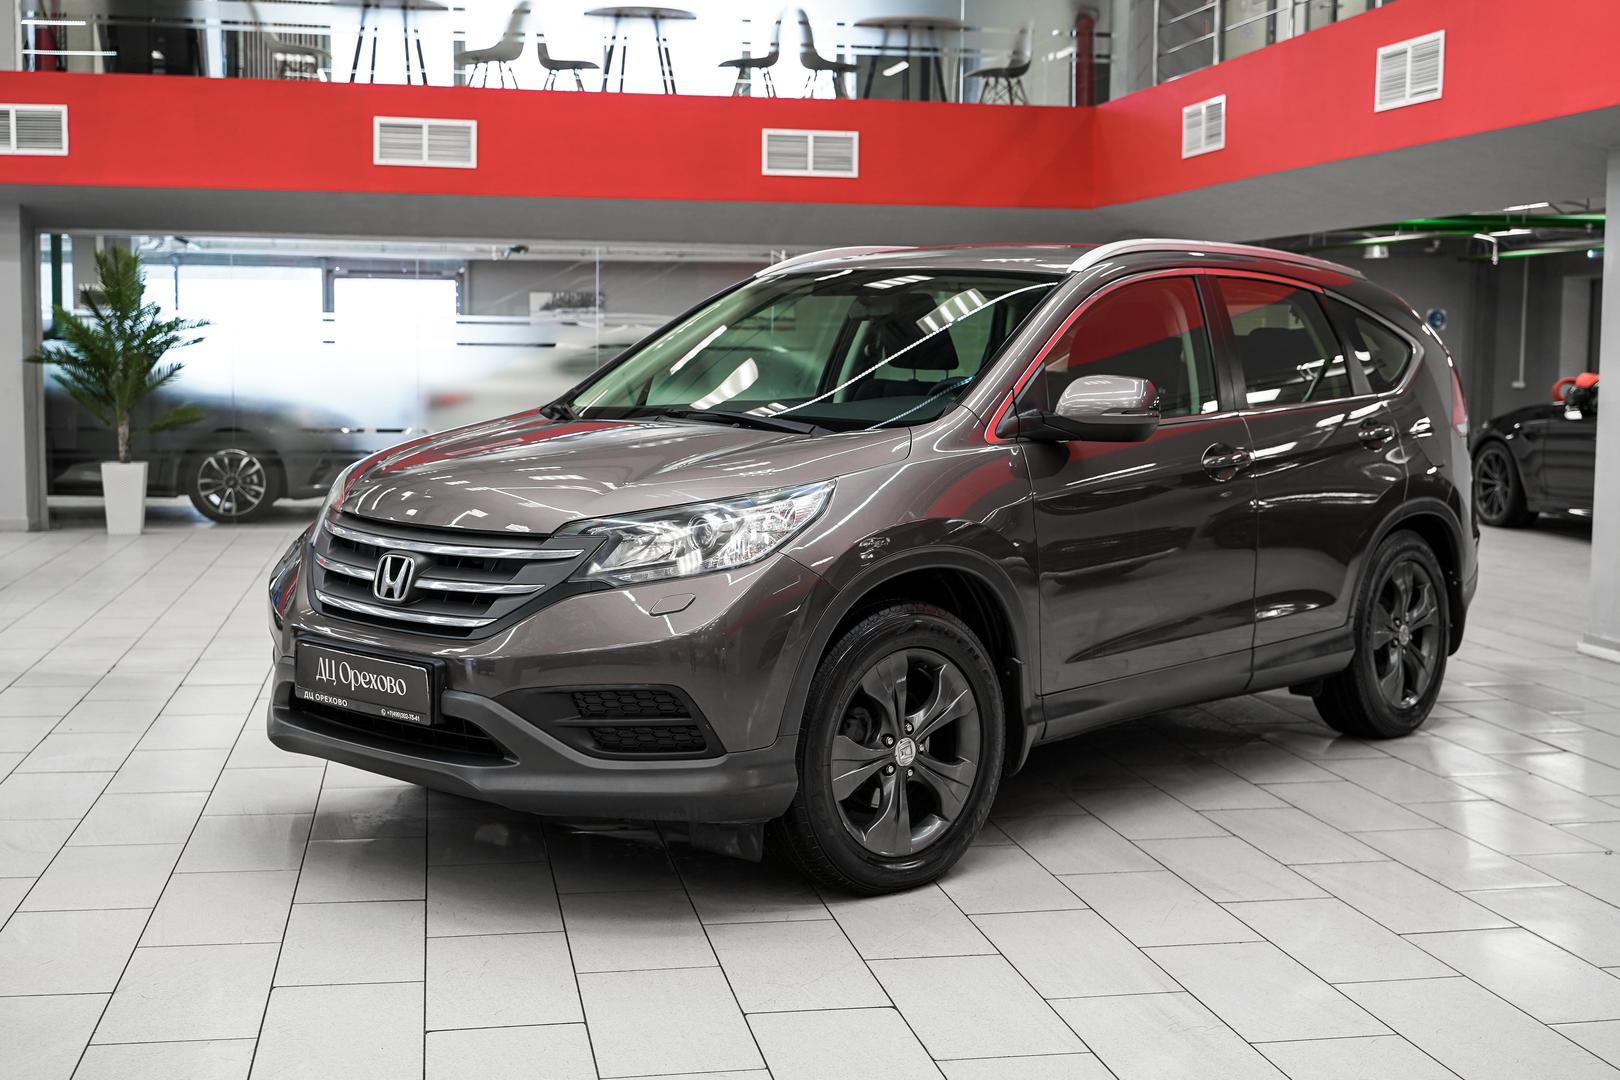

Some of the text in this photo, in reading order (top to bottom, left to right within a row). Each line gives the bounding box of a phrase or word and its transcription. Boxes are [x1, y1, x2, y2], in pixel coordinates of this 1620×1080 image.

[315, 656, 407, 696] ДЦ Орехово
[303, 690, 348, 707] ДЦ ОРЕХОВО
